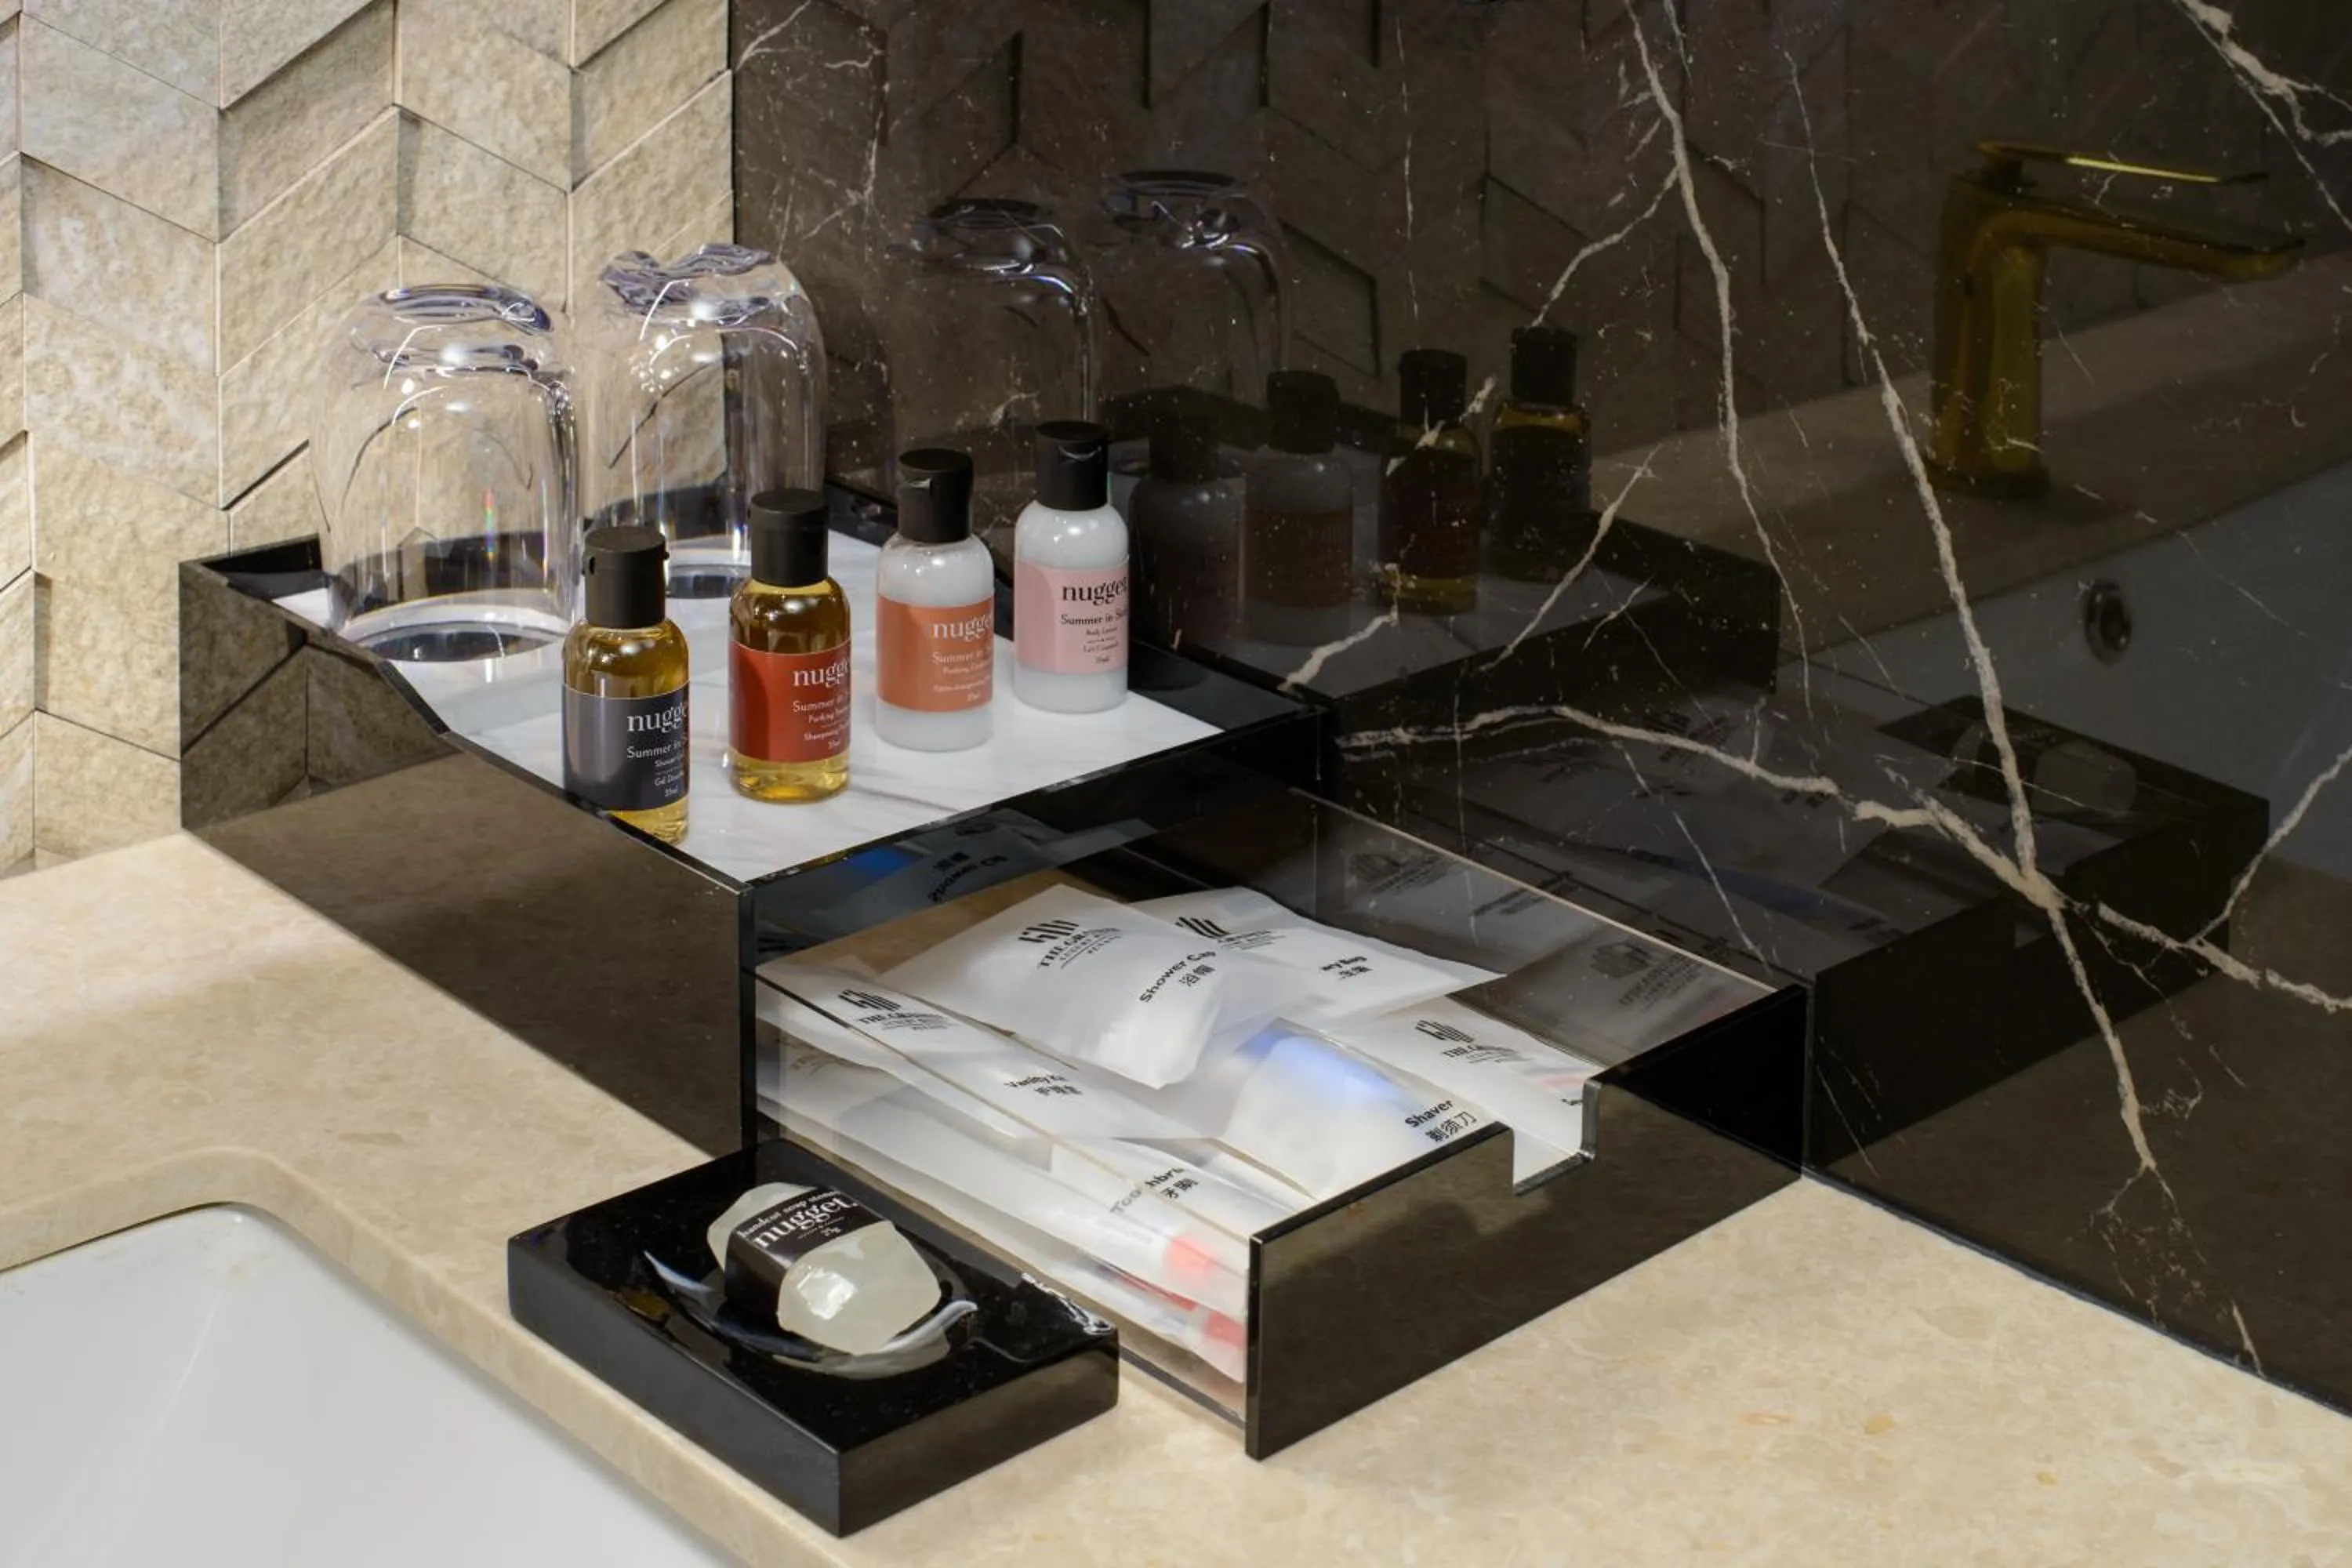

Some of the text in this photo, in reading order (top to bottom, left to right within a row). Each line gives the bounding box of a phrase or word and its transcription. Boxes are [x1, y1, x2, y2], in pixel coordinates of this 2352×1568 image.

[1061, 614, 1103, 626] Summer
[792, 699, 835, 713] Summer
[626, 744, 673, 759] Summer
[1139, 960, 1188, 1003] Shower
[1404, 1100, 1454, 1128] Shaver
